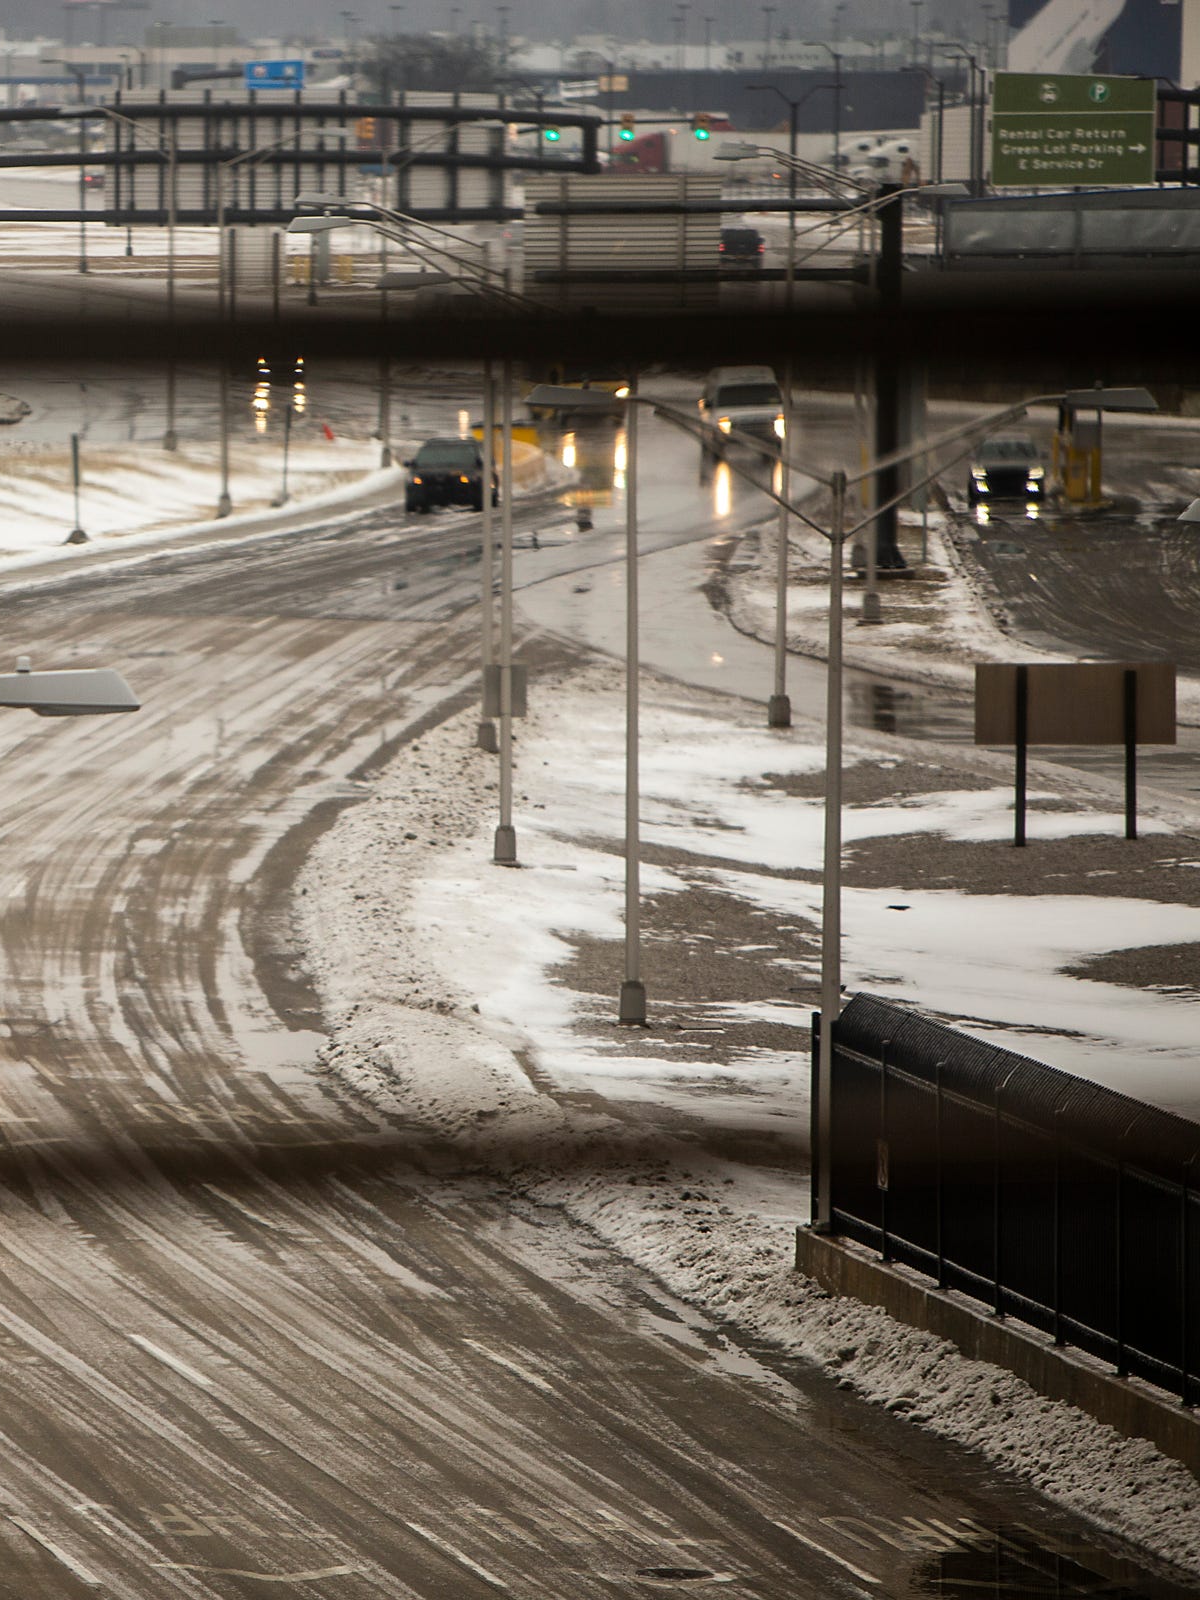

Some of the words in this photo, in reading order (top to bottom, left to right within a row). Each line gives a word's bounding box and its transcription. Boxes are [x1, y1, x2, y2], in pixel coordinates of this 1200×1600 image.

[999, 129, 1043, 139] Rental
[1047, 129, 1071, 139] Car
[1075, 128, 1126, 139] Return
[1001, 144, 1040, 155] Green
[1043, 144, 1067, 154] Lot
[1071, 143, 1123, 156] Parking
[1032, 159, 1084, 169] Service
[1088, 158, 1104, 169] Dr
